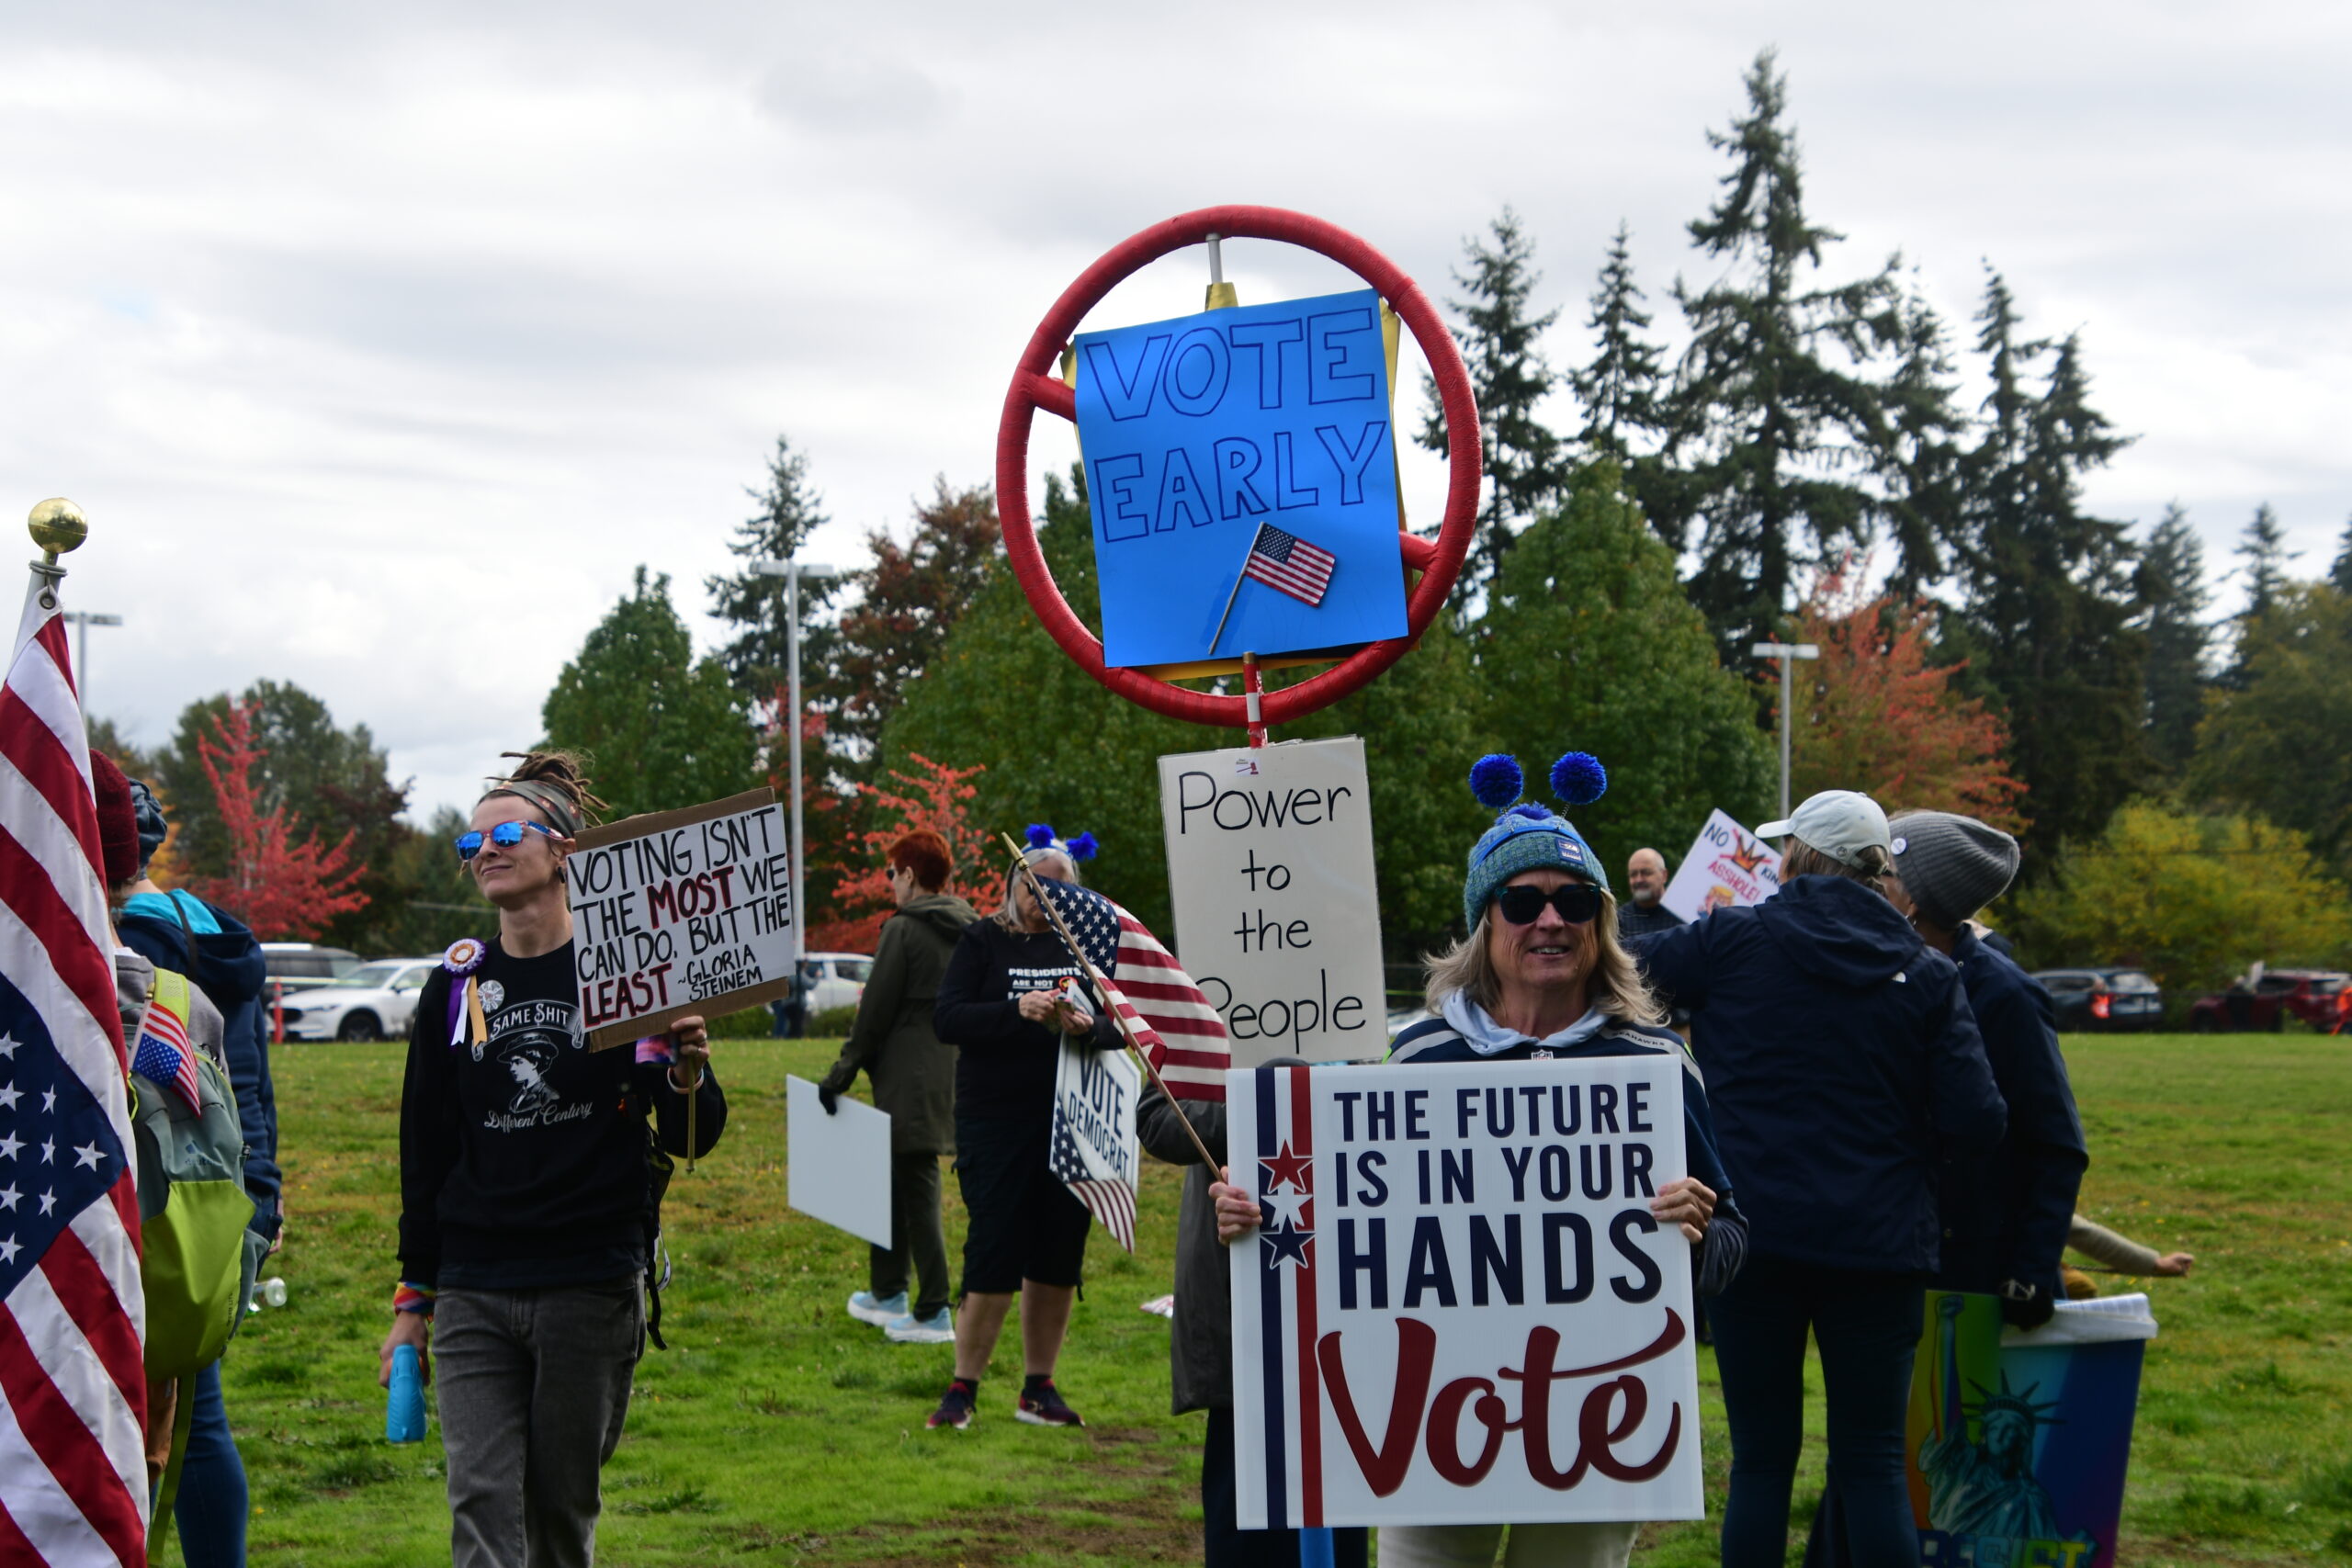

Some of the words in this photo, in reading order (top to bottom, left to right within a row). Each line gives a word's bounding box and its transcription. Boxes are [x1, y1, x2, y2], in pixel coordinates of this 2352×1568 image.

[1085, 308, 1375, 422] VOTE
[1093, 421, 1387, 543] EARLY
[1179, 771, 1351, 834] Power
[568, 829, 692, 897] VOTING
[702, 807, 776, 871] ISN'T
[1241, 849, 1291, 891] to
[1704, 822, 1729, 847] NO
[1760, 865, 1781, 886] KIN
[1707, 860, 1761, 903] ASSHOLE!
[572, 891, 640, 945] THE
[647, 865, 734, 930] MOST
[741, 853, 788, 896] WE
[1234, 908, 1312, 953] the
[577, 937, 626, 983] CAN
[688, 906, 741, 956] BUT
[744, 893, 790, 937] THE
[582, 963, 673, 1028] LEAST
[689, 965, 763, 1002] STEINEM
[1009, 967, 1082, 976] PRESIDENTS
[490, 1008, 531, 1038] SAME
[534, 1003, 569, 1026] SHIT
[483, 1111, 538, 1134] Different
[539, 1101, 594, 1125] Century
[1080, 1044, 1125, 1140] VOTE
[1334, 1089, 1430, 1143] THE
[1456, 1082, 1654, 1139] FUTURE
[1068, 1090, 1129, 1181] DEMOCRAT
[1335, 1150, 1388, 1208] IS
[1418, 1148, 1475, 1205] IN
[1500, 1143, 1656, 1201] YOUR
[1337, 1209, 1663, 1310] HANDS
[1317, 1306, 1687, 1499] Vote
